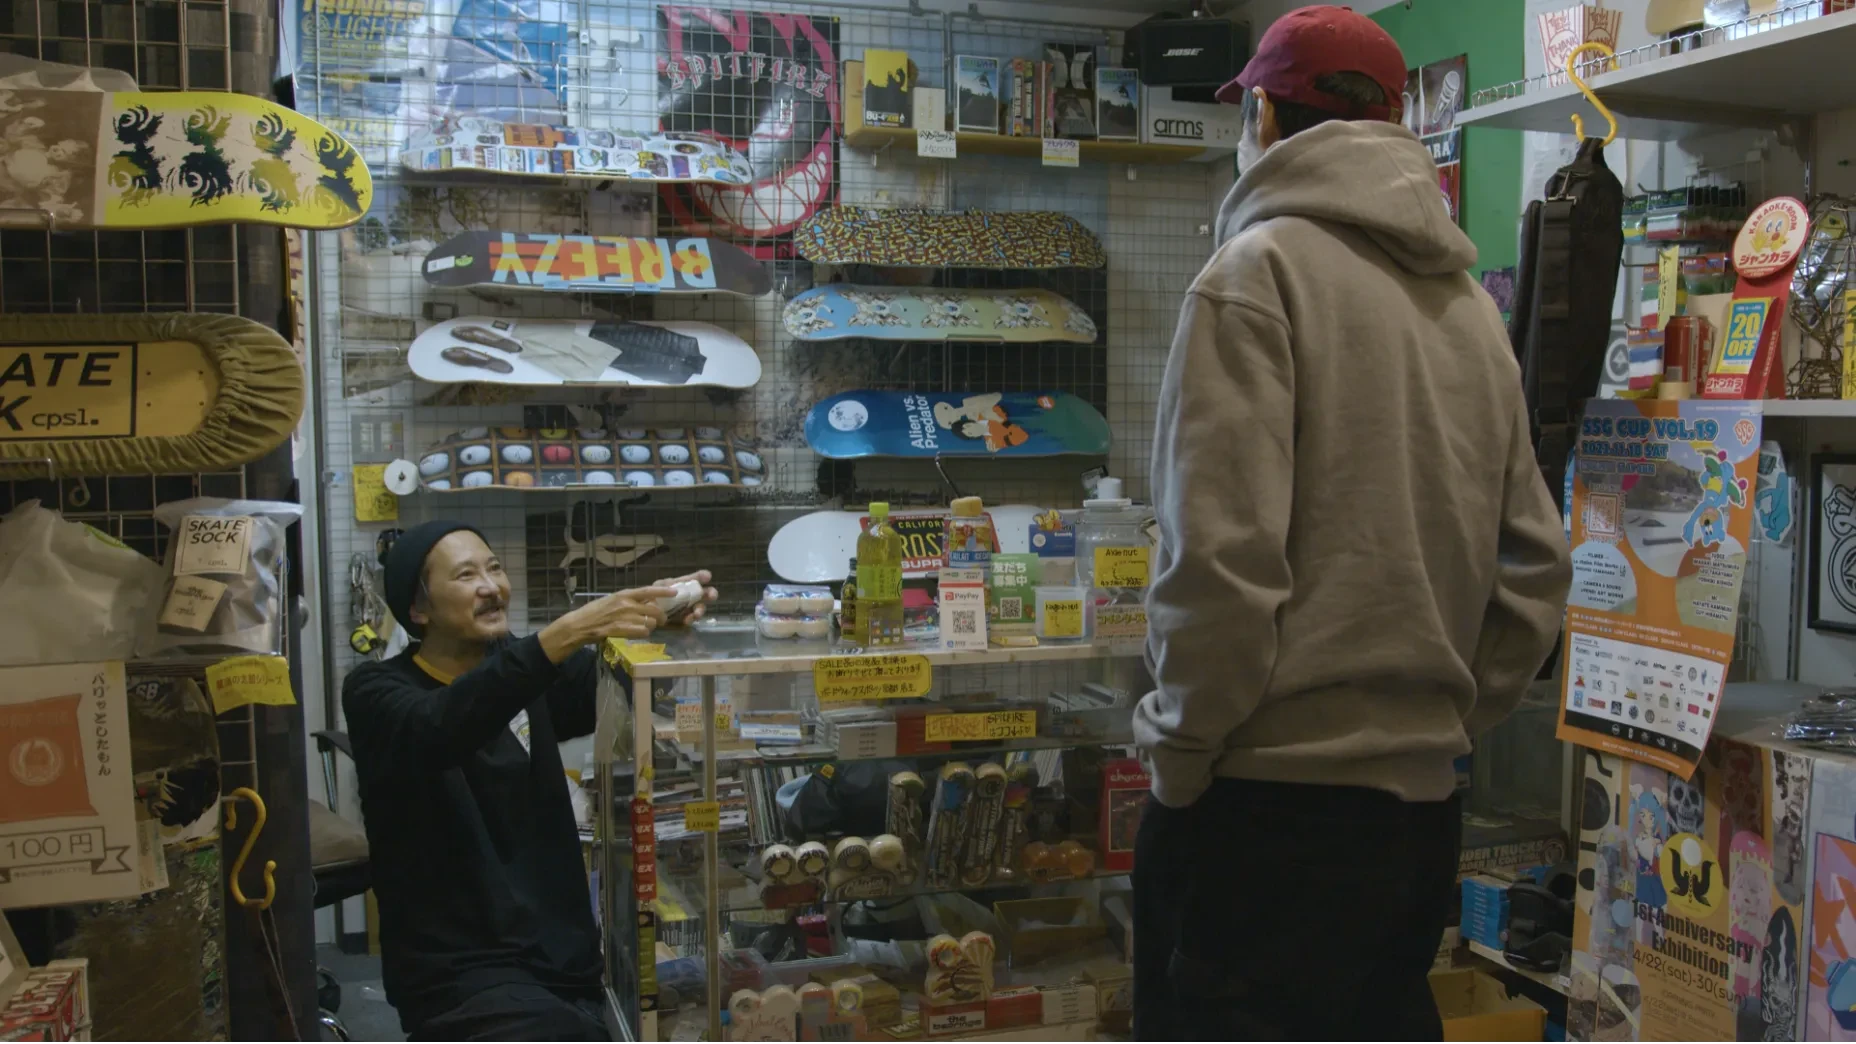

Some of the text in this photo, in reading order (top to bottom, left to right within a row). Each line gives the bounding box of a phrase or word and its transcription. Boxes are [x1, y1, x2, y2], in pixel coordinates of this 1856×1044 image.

[1162, 48, 1204, 57] BOSE
[666, 52, 832, 98] SPITFIRE
[1154, 118, 1204, 137] arms
[491, 232, 716, 288] BREEZY
[1740, 251, 1791, 266] ジャンカラ
[1727, 339, 1756, 357] OFF
[0, 352, 119, 388] ATE
[1706, 378, 1744, 389] ジャンカラ
[908, 415, 925, 449] Alien
[915, 395, 938, 450] Predator
[1583, 418, 1612, 437] SSG
[1616, 418, 1651, 438] CUP
[189, 520, 244, 532] SKATE
[899, 521, 944, 529] CALIFOR
[191, 532, 238, 544] SOCK
[900, 534, 944, 557] ROS
[954, 592, 980, 601] PayPay
[1656, 908, 1753, 964] Anniversary
[1652, 930, 1729, 981] Exhibition
